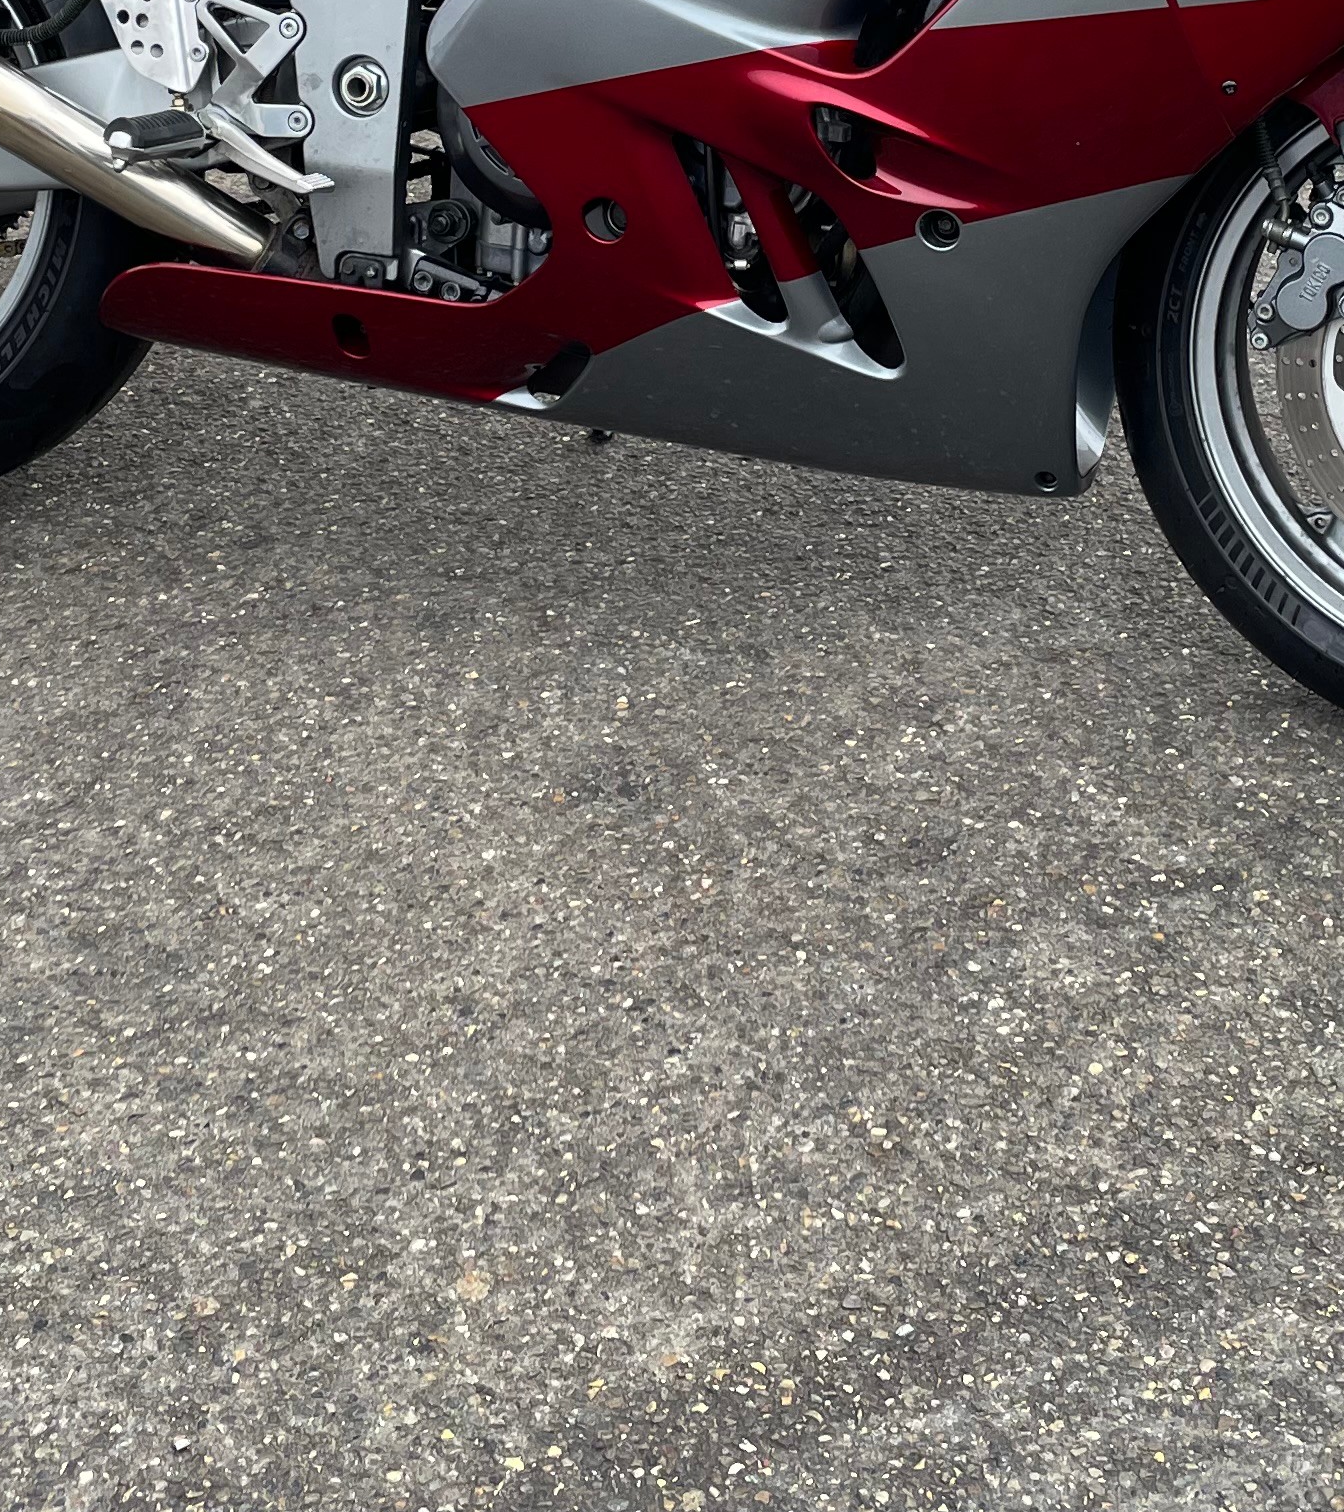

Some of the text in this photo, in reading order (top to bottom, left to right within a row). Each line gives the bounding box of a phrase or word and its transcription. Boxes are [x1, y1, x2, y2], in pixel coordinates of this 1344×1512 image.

[1178, 228, 1200, 273] FRONT
[1166, 283, 1184, 325] 2CT
[1298, 261, 1331, 304] TOKICO
